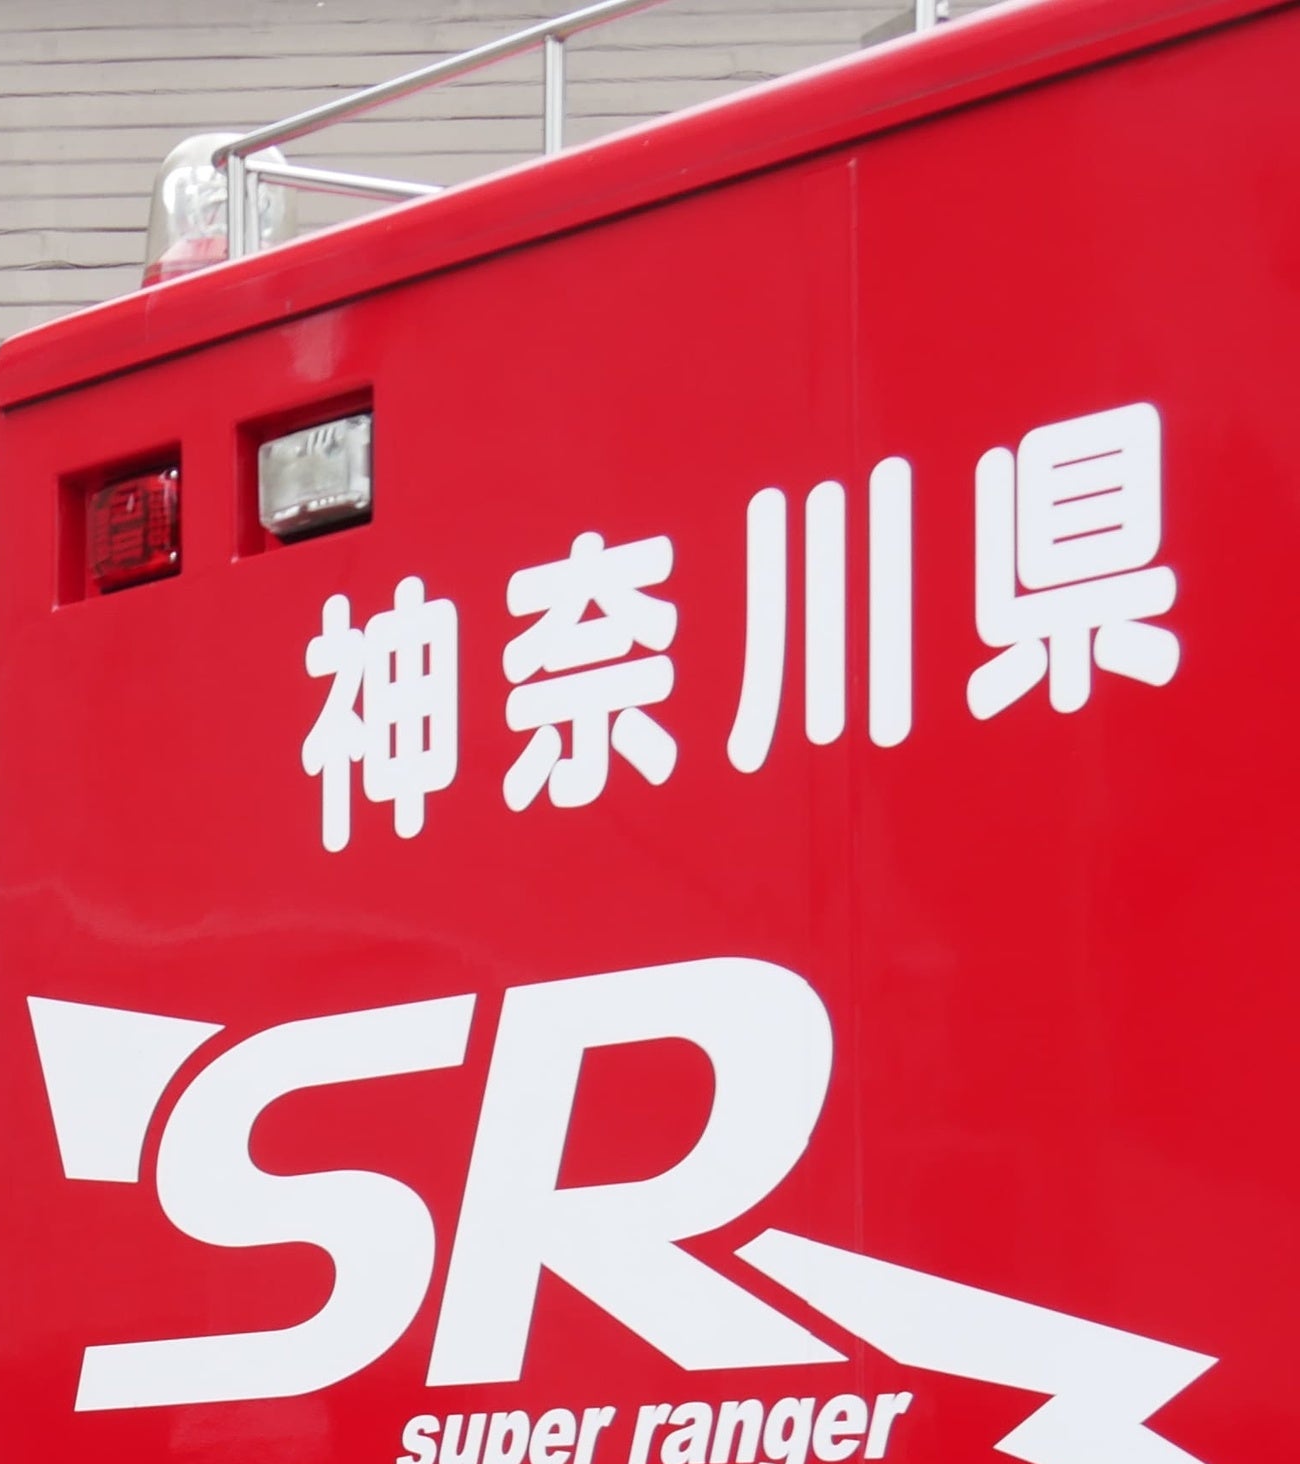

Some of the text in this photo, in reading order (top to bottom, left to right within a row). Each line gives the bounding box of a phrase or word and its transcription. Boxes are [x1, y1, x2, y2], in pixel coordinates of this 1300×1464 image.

[301, 401, 1181, 853] 神奈川県
[75, 956, 850, 1413] SR
